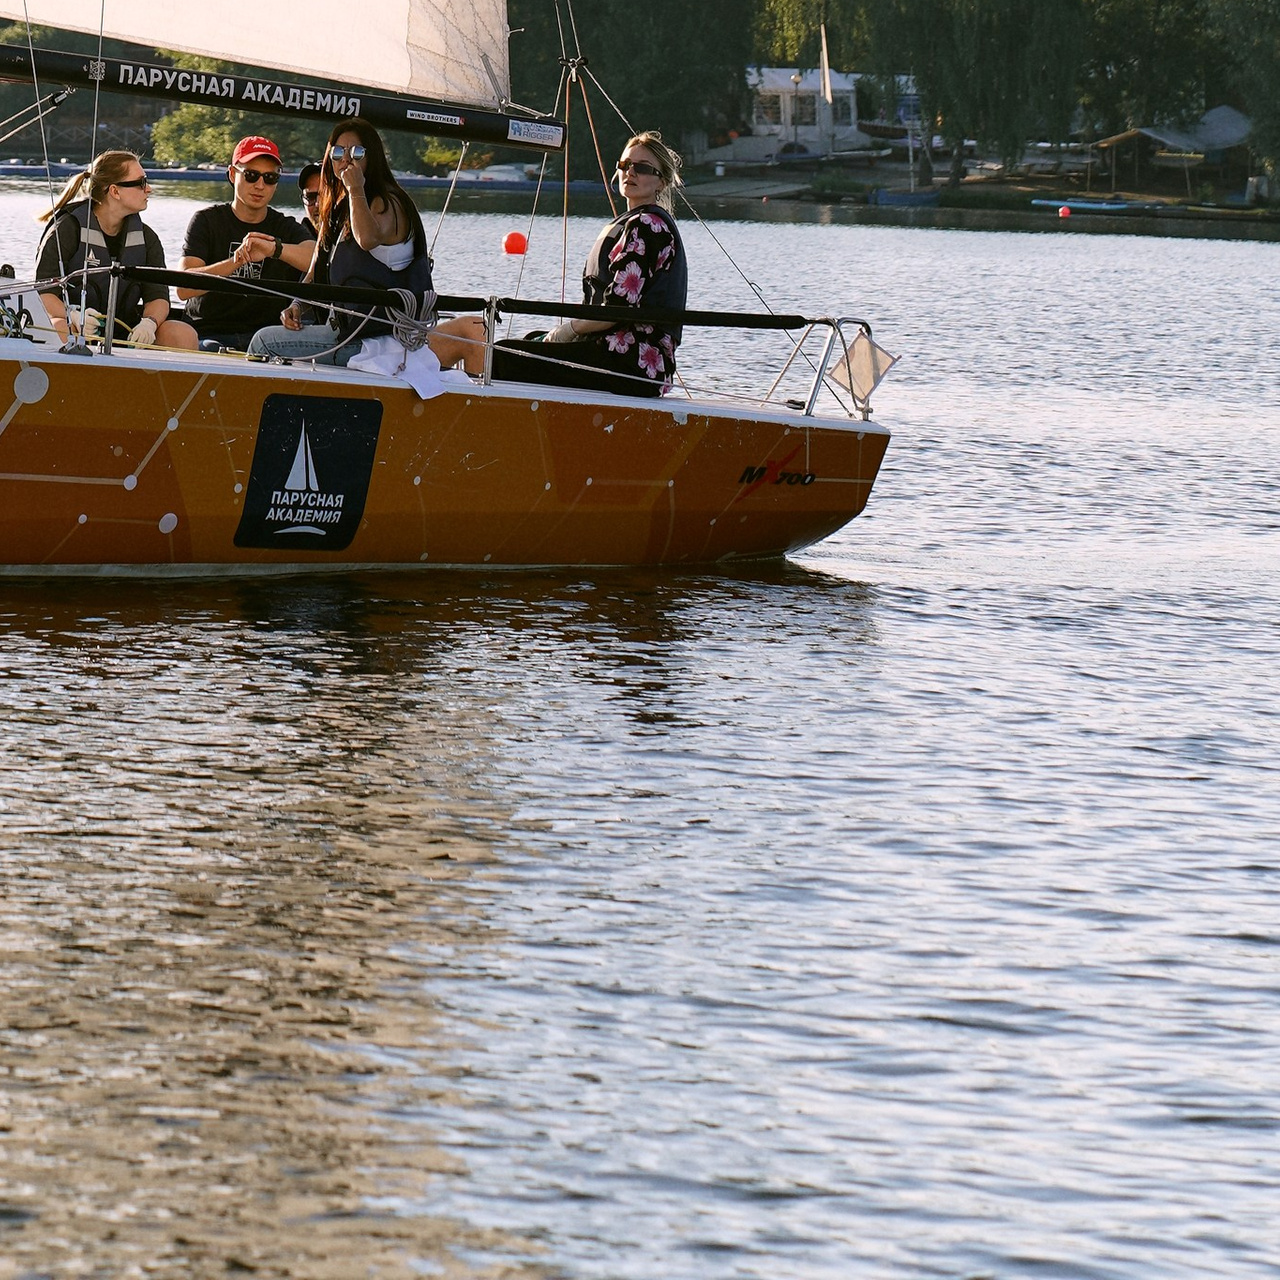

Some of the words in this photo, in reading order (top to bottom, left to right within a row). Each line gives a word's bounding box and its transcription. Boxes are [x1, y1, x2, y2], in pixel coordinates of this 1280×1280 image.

[118, 64, 235, 98] ПАРУСНАЯ
[241, 82, 361, 117] АКАДЕМИЯ
[427, 114, 457, 124] BROTHERS
[522, 130, 554, 142] RIGGER
[734, 443, 816, 503] MX700
[271, 491, 344, 508] ПАРУСНАЯ
[265, 507, 342, 524] АКАДЕМИЯ
